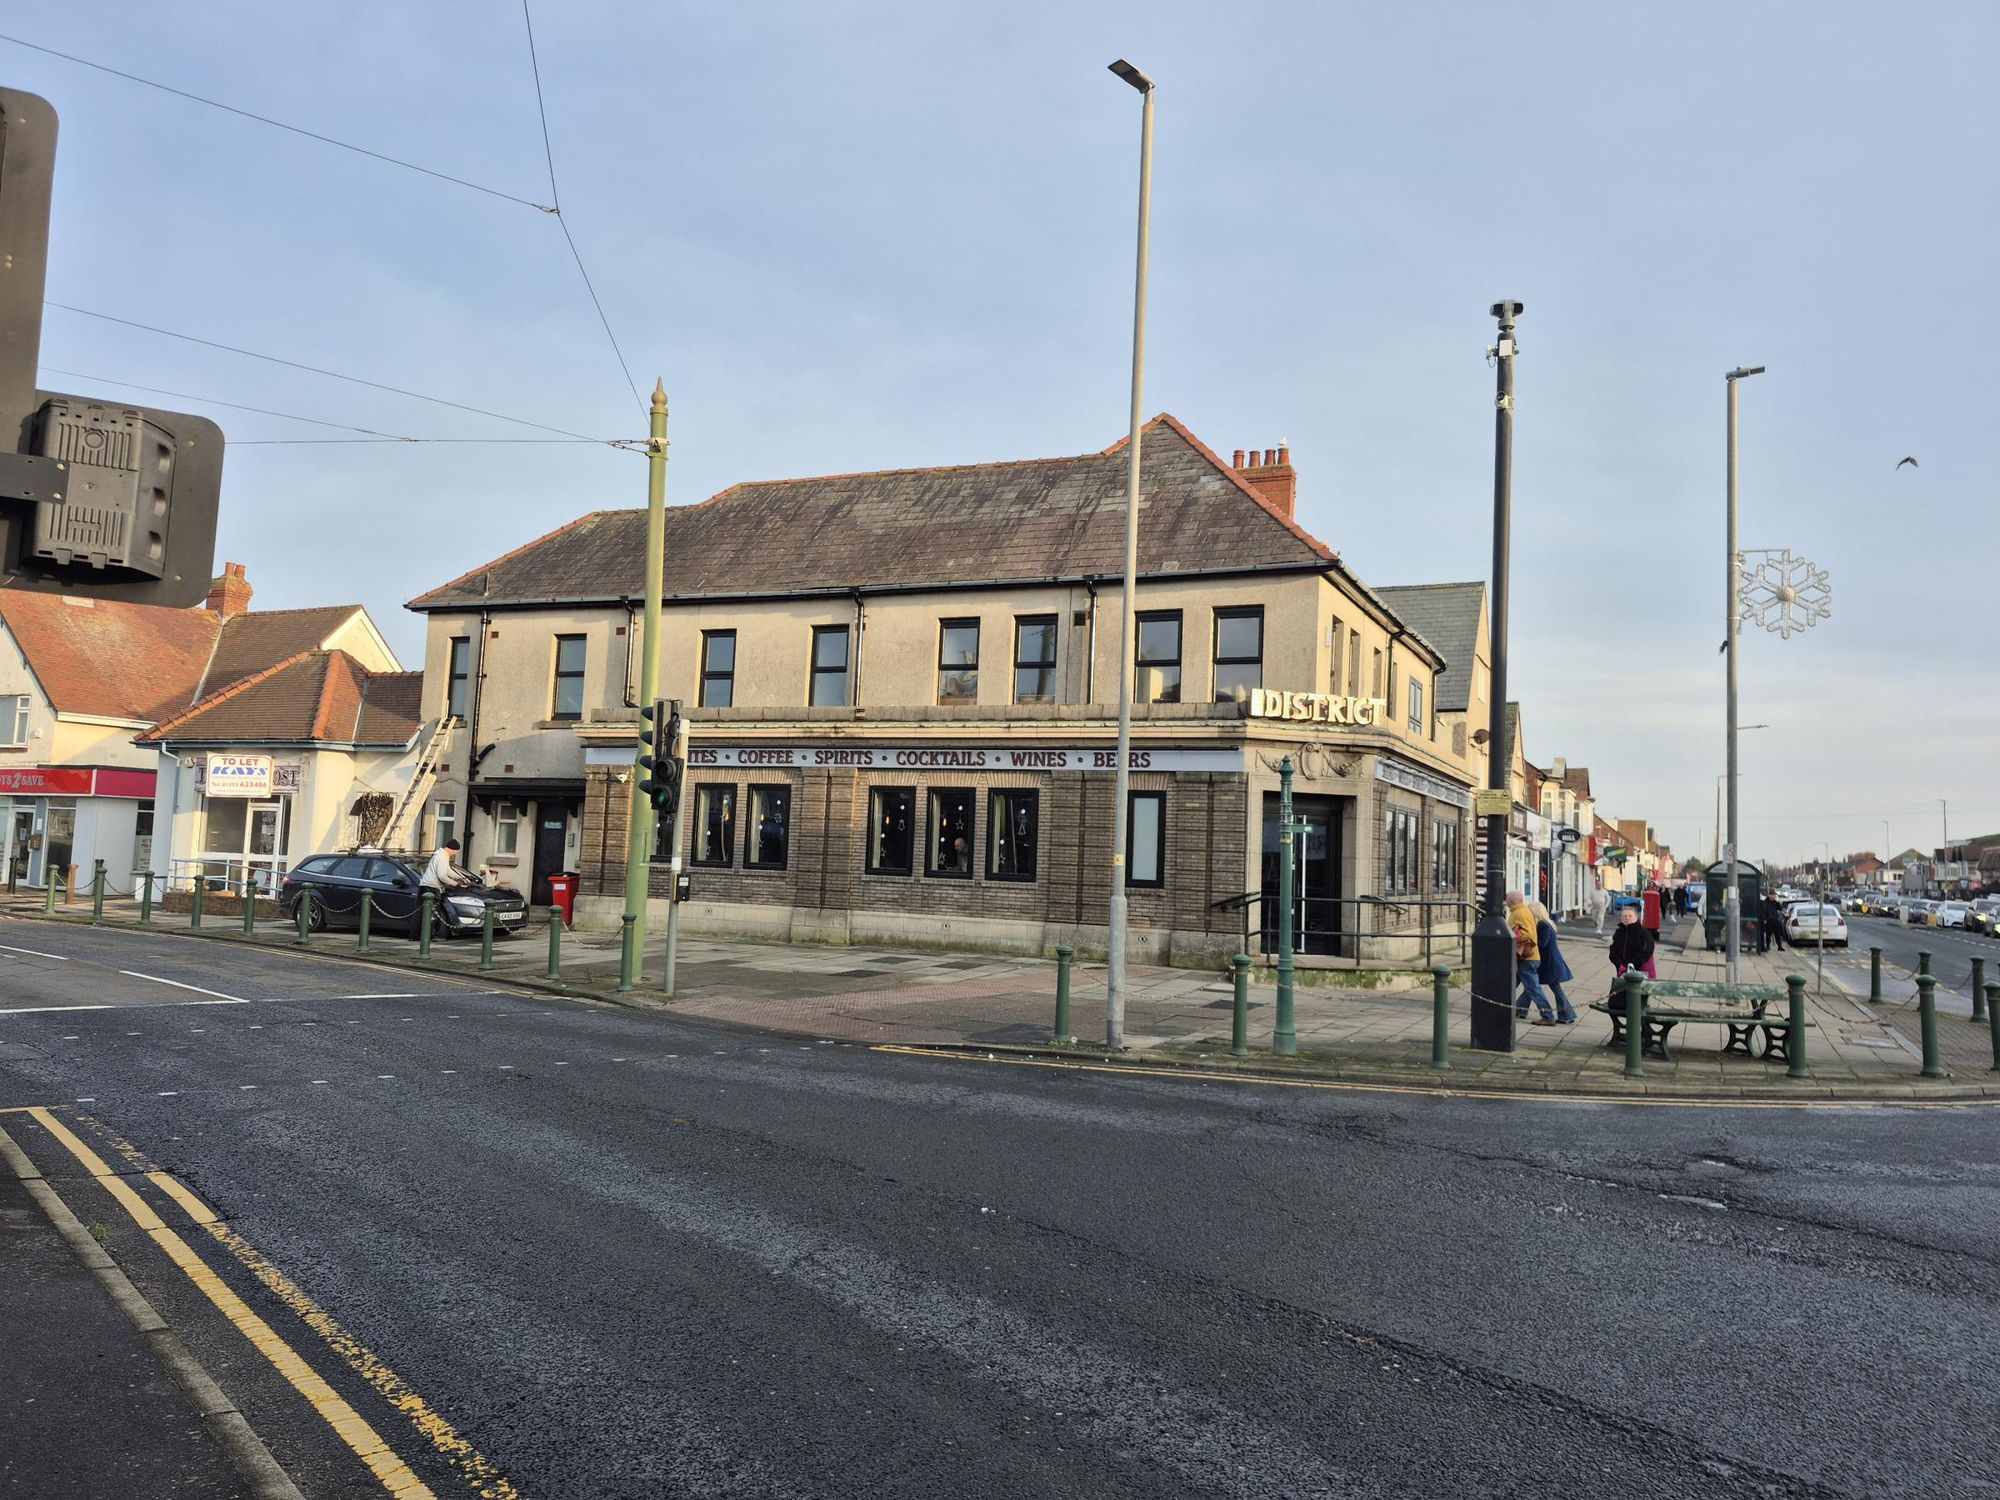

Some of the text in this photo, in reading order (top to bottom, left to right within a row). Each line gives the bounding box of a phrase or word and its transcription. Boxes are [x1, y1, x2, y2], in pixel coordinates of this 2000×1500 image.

[1264, 689, 1387, 725] DISTRICT
[688, 749, 1151, 768] ITES COFFEE SPIRITS COCKTAILS WINES BERS
[212, 767, 267, 775] KAYS
[10, 773, 21, 788] 2
[21, 775, 44, 785] SAVE
